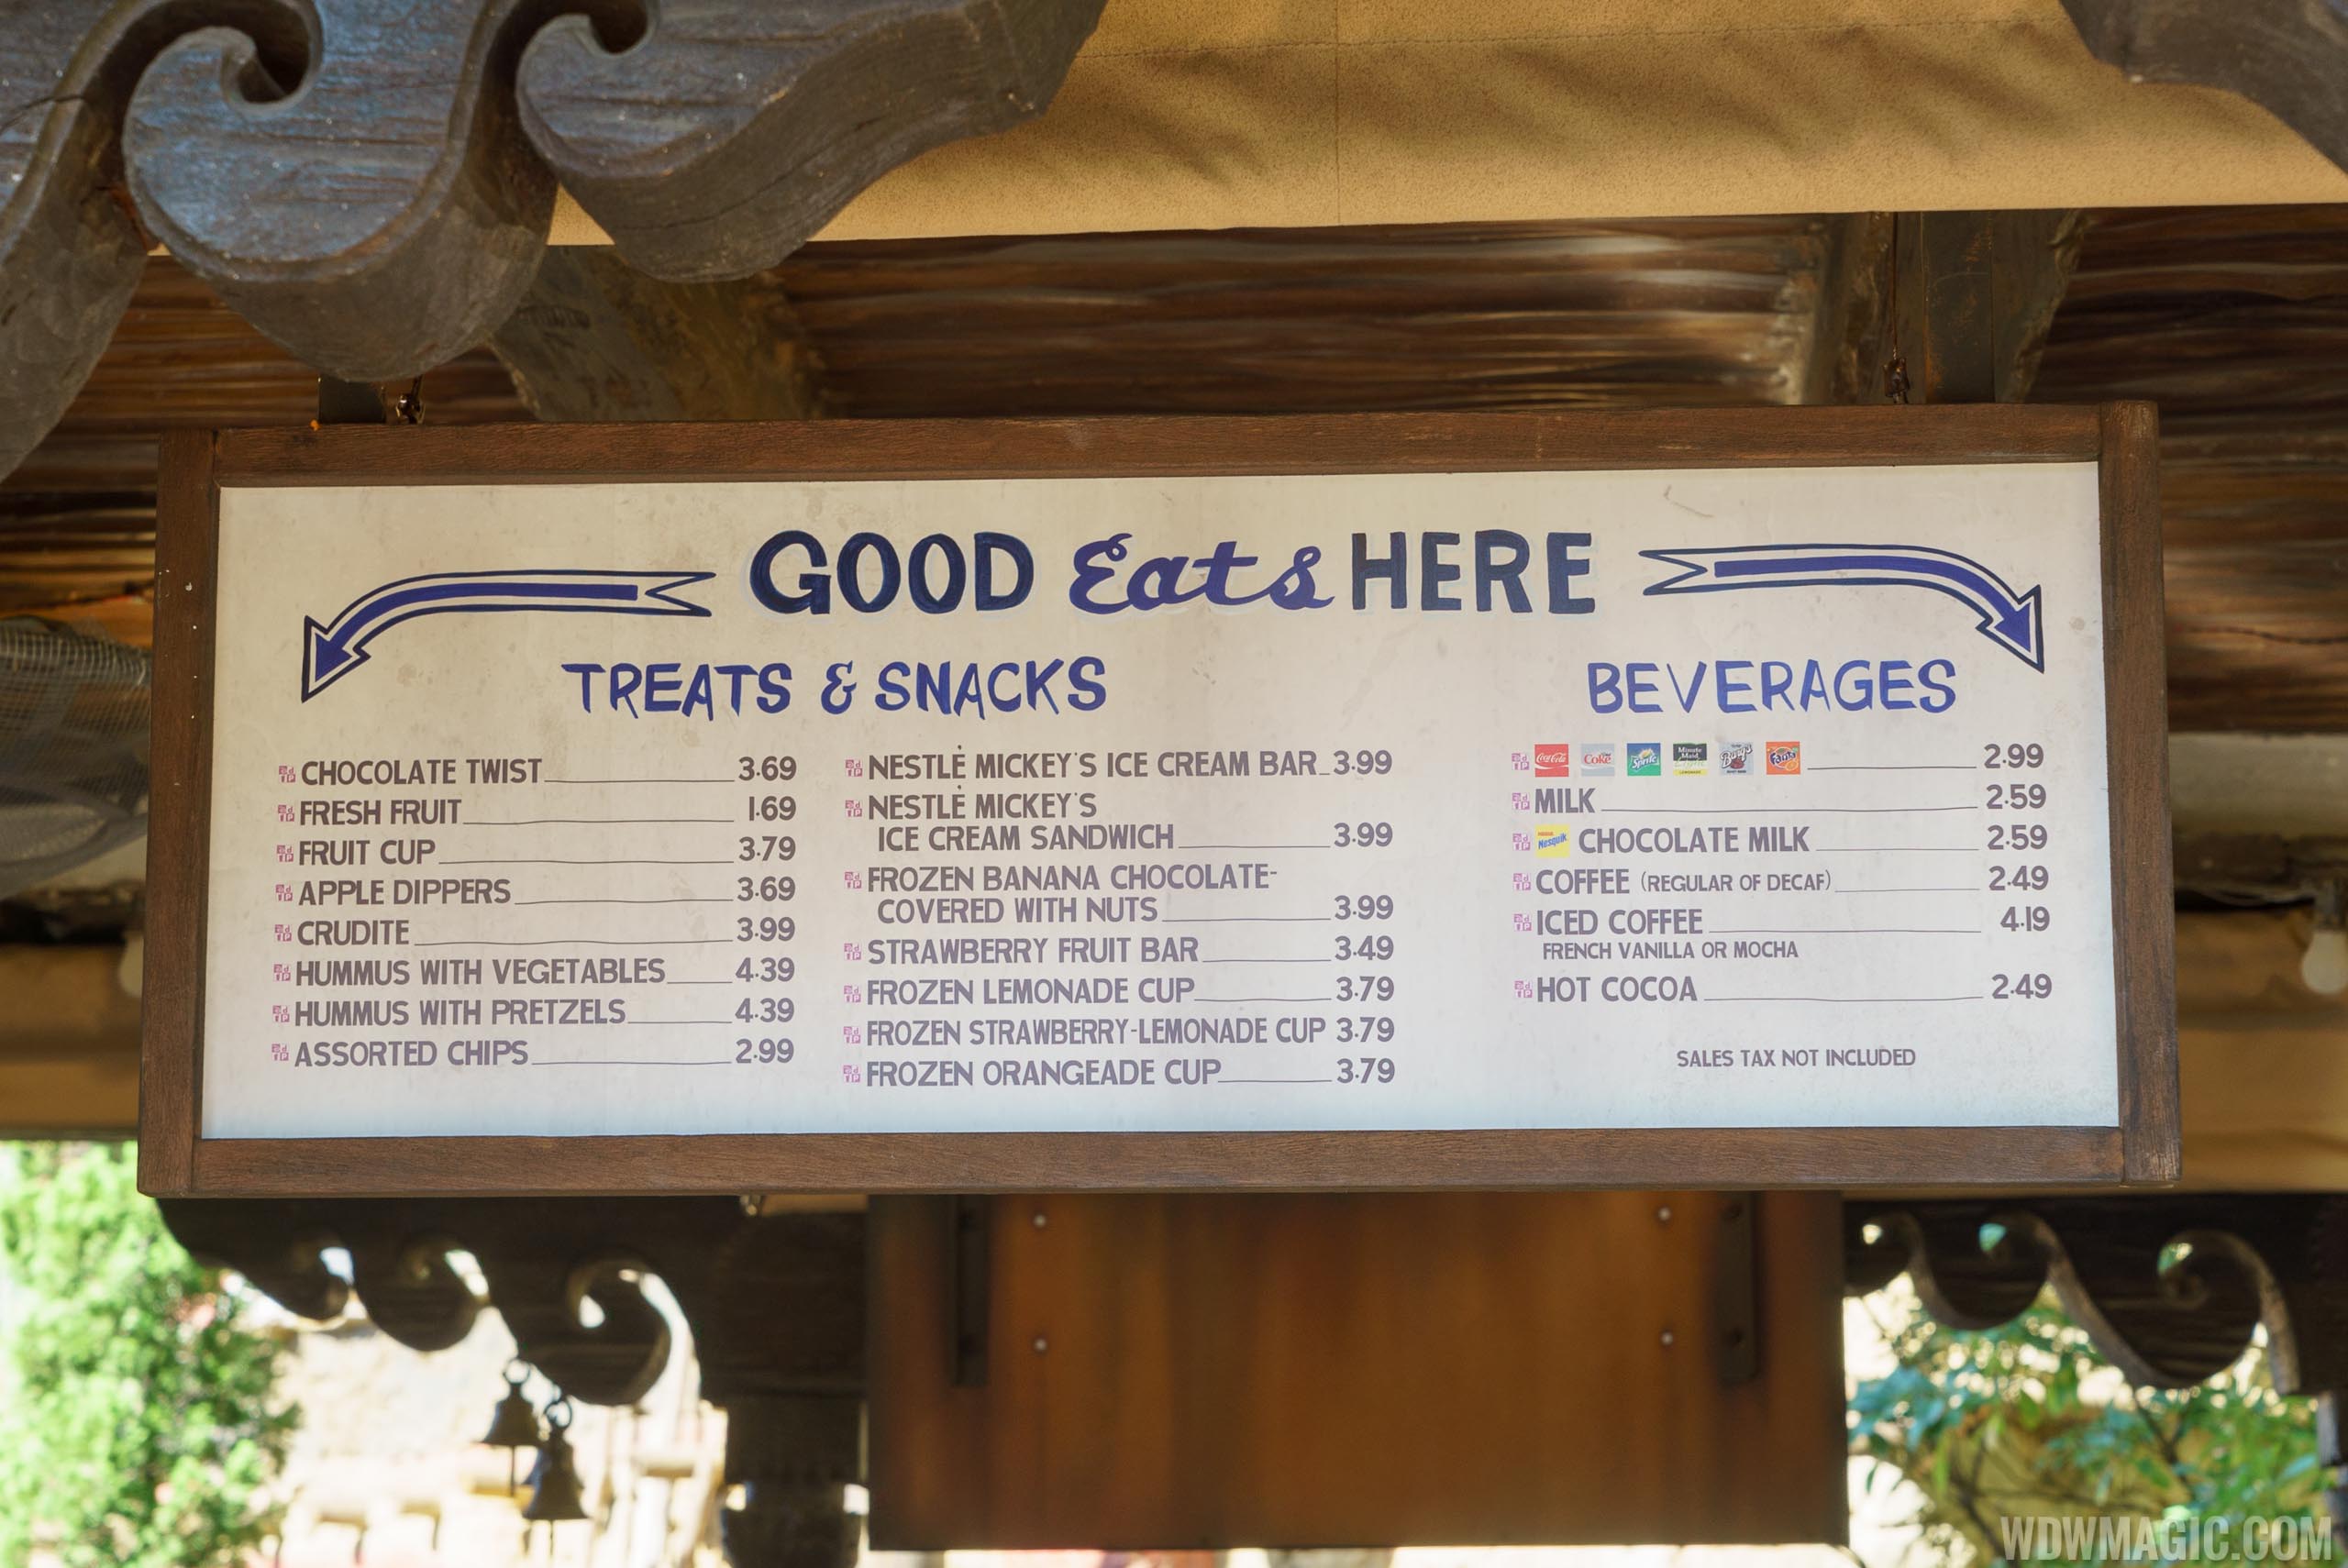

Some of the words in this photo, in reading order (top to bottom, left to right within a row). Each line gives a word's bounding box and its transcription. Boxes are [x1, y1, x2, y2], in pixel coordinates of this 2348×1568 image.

[750, 530, 1034, 614] GOOD
[1069, 533, 1335, 614] Eats
[1352, 529, 1595, 614] HERE
[561, 663, 792, 721] TREATS
[821, 660, 857, 714] &
[875, 657, 1106, 720] SNACKS
[1588, 659, 1955, 713] BEVERAGES
[976, 753, 1097, 778] MICKEY'S
[1108, 752, 1147, 777] ICE
[1157, 751, 1249, 777] CREAM
[1260, 751, 1316, 776] BAR
[1334, 750, 1392, 775] 3.99
[1633, 755, 1656, 769] Sprite
[1770, 752, 1795, 765] Fanta
[1984, 744, 2043, 768] 2.99
[302, 759, 456, 785] CHOCOLATE
[466, 758, 542, 783] TWIST
[738, 756, 796, 781] 3.69
[301, 801, 381, 825] FRESH
[391, 800, 461, 824] FRUIT
[749, 796, 796, 821] 1.69
[976, 792, 1096, 819] MICKEY'S
[1535, 788, 1595, 813] MILK
[1987, 784, 2046, 809] 2.59
[299, 840, 370, 866] FRUIT
[381, 840, 436, 865] CUP
[739, 836, 795, 861] 3.79
[879, 826, 919, 851] ICE
[929, 825, 1020, 851] CREAM
[1031, 824, 1173, 850] SANDWICH
[1335, 823, 1392, 847] 3.99
[1538, 833, 1567, 850] Nesquik
[1579, 827, 1739, 853] CHOCOLATE
[1749, 826, 1810, 852] MILK
[1988, 824, 2047, 850] 2.59
[299, 880, 383, 905] APPLE
[393, 879, 511, 904] DIPPERS
[737, 876, 795, 901] 3.69
[869, 867, 973, 892] FROZEN
[984, 866, 1100, 890] BANANA
[1111, 864, 1277, 889] CHOCOLATE-
[1536, 869, 1630, 894] COFFEE
[1642, 871, 1733, 891] (REGULAR
[1740, 875, 1760, 890] OF
[1767, 869, 1831, 890] DECAF)
[1989, 866, 2048, 890] 2.49
[878, 899, 1004, 923] COVERED
[1014, 898, 1076, 922] WITH
[1087, 897, 1157, 922] NUTS
[1335, 895, 1393, 920] 3.99
[1537, 910, 1598, 935] ICED
[1609, 909, 1702, 934] COFFEE
[2000, 906, 2050, 932] 4.19
[298, 920, 409, 945] CRUDITE
[737, 917, 795, 942] 3.99
[869, 938, 1048, 964] STRAWBERRY
[1059, 937, 1131, 963] FRUIT
[1142, 937, 1198, 962] BAR
[1335, 935, 1393, 960] 3.49
[1544, 943, 1611, 959] FRENCH
[1618, 942, 1695, 959] VANILLA
[1702, 942, 1727, 958] OR
[1734, 941, 1799, 958] MOCHA
[296, 960, 410, 986] HUMMUS
[421, 959, 482, 985] WITH
[493, 958, 665, 984] VEGETABLES
[736, 957, 794, 982] 4.39
[868, 979, 973, 1005] FROZEN
[984, 978, 1128, 1004] LEMONADE
[1138, 977, 1194, 1003] CUP
[1336, 976, 1394, 1001] 3.79
[1537, 977, 1590, 1002] HOT
[1601, 977, 1698, 1001] COCOA
[1992, 974, 2052, 999] 2.49
[295, 1000, 409, 1026] HUMMUS
[420, 999, 481, 1025] WITH
[493, 999, 626, 1024] PRETZELS
[735, 998, 794, 1022] 4.39
[868, 1021, 960, 1045] FROZEN
[969, 1018, 1267, 1044] STRAWBERRY-LEMONADE
[1276, 1018, 1325, 1043] CUP
[1336, 1017, 1394, 1043] 3.79
[294, 1041, 437, 1066] ASSORTED
[448, 1041, 528, 1066] CHIPS
[736, 1038, 793, 1064] 2.99
[1678, 1050, 1733, 1066] SALES
[1741, 1050, 1776, 1066] TAX
[1782, 1050, 1819, 1066] NOT
[1826, 1049, 1915, 1066] INCLUDED
[868, 1061, 973, 1087] FROZEN
[983, 1060, 1155, 1086] ORANGEADE
[1165, 1058, 1221, 1084] CUP
[1337, 1058, 1395, 1083] 3.79
